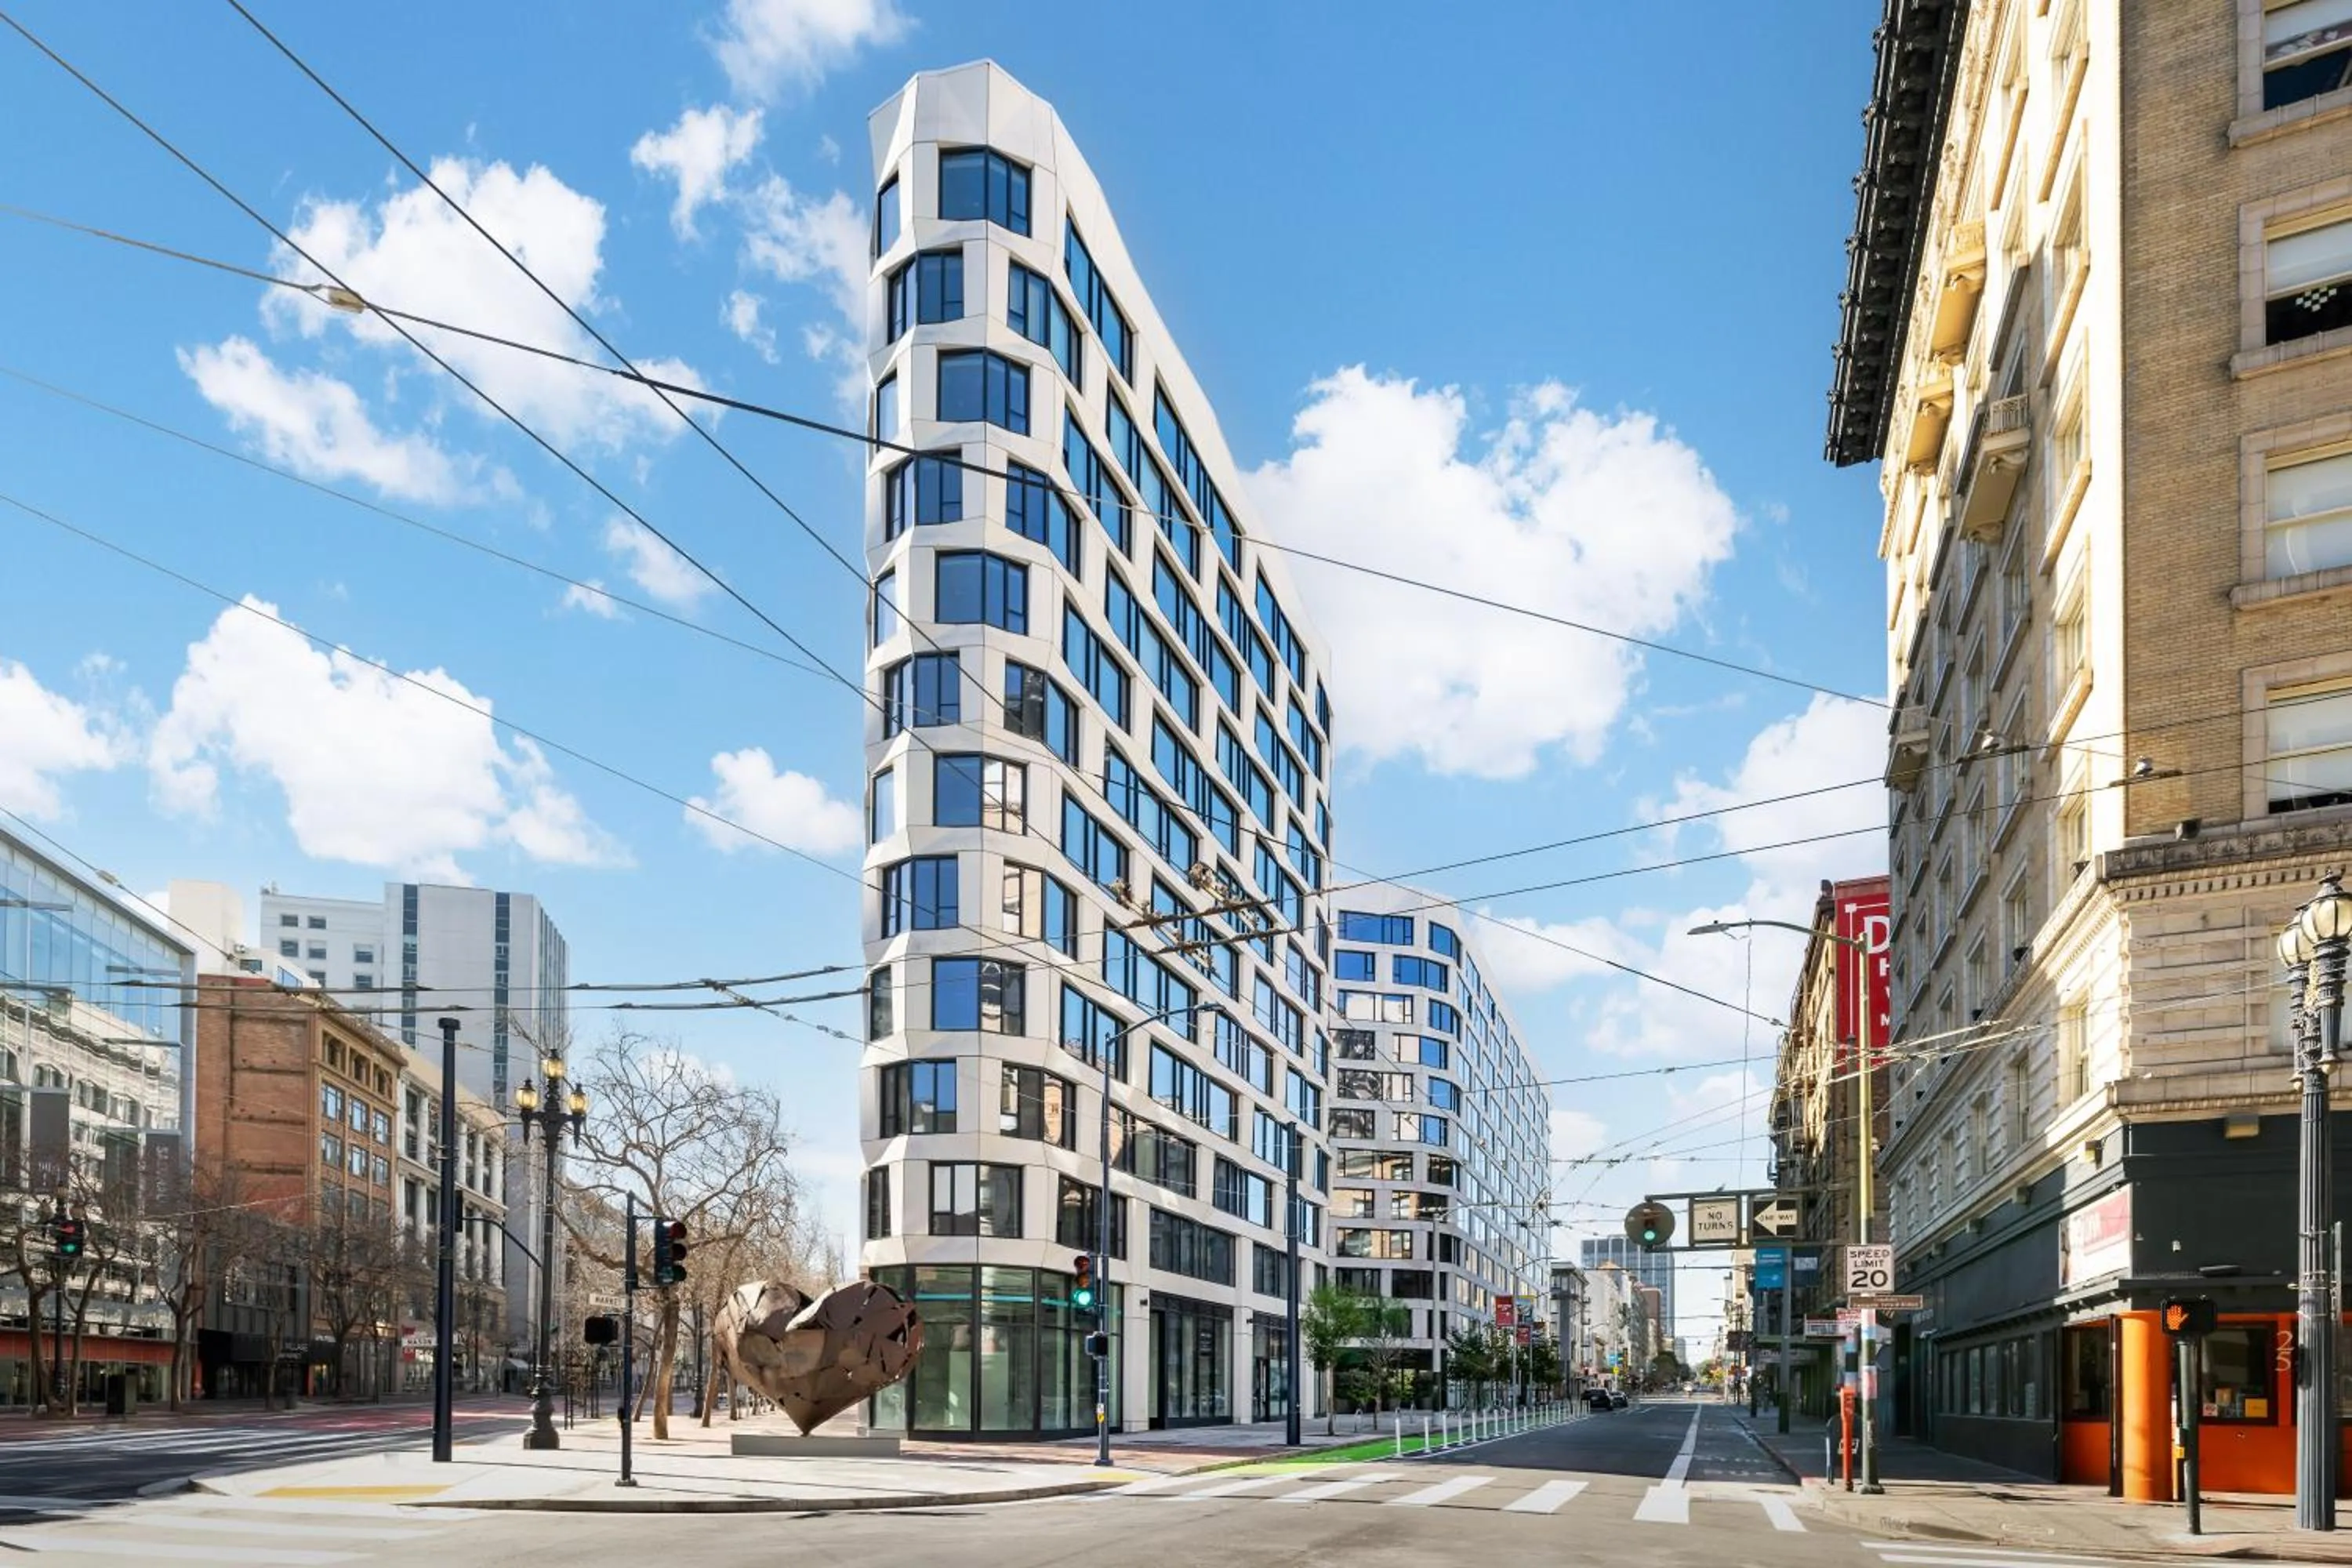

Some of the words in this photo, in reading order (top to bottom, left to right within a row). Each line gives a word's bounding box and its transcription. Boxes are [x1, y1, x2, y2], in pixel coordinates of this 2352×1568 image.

[1708, 1211, 1723, 1221] NO
[1698, 1222, 1733, 1231] TURNS
[1850, 1249, 1889, 1258] SPEED
[1854, 1259, 1884, 1268] LIMIT
[1851, 1269, 1888, 1287] 20
